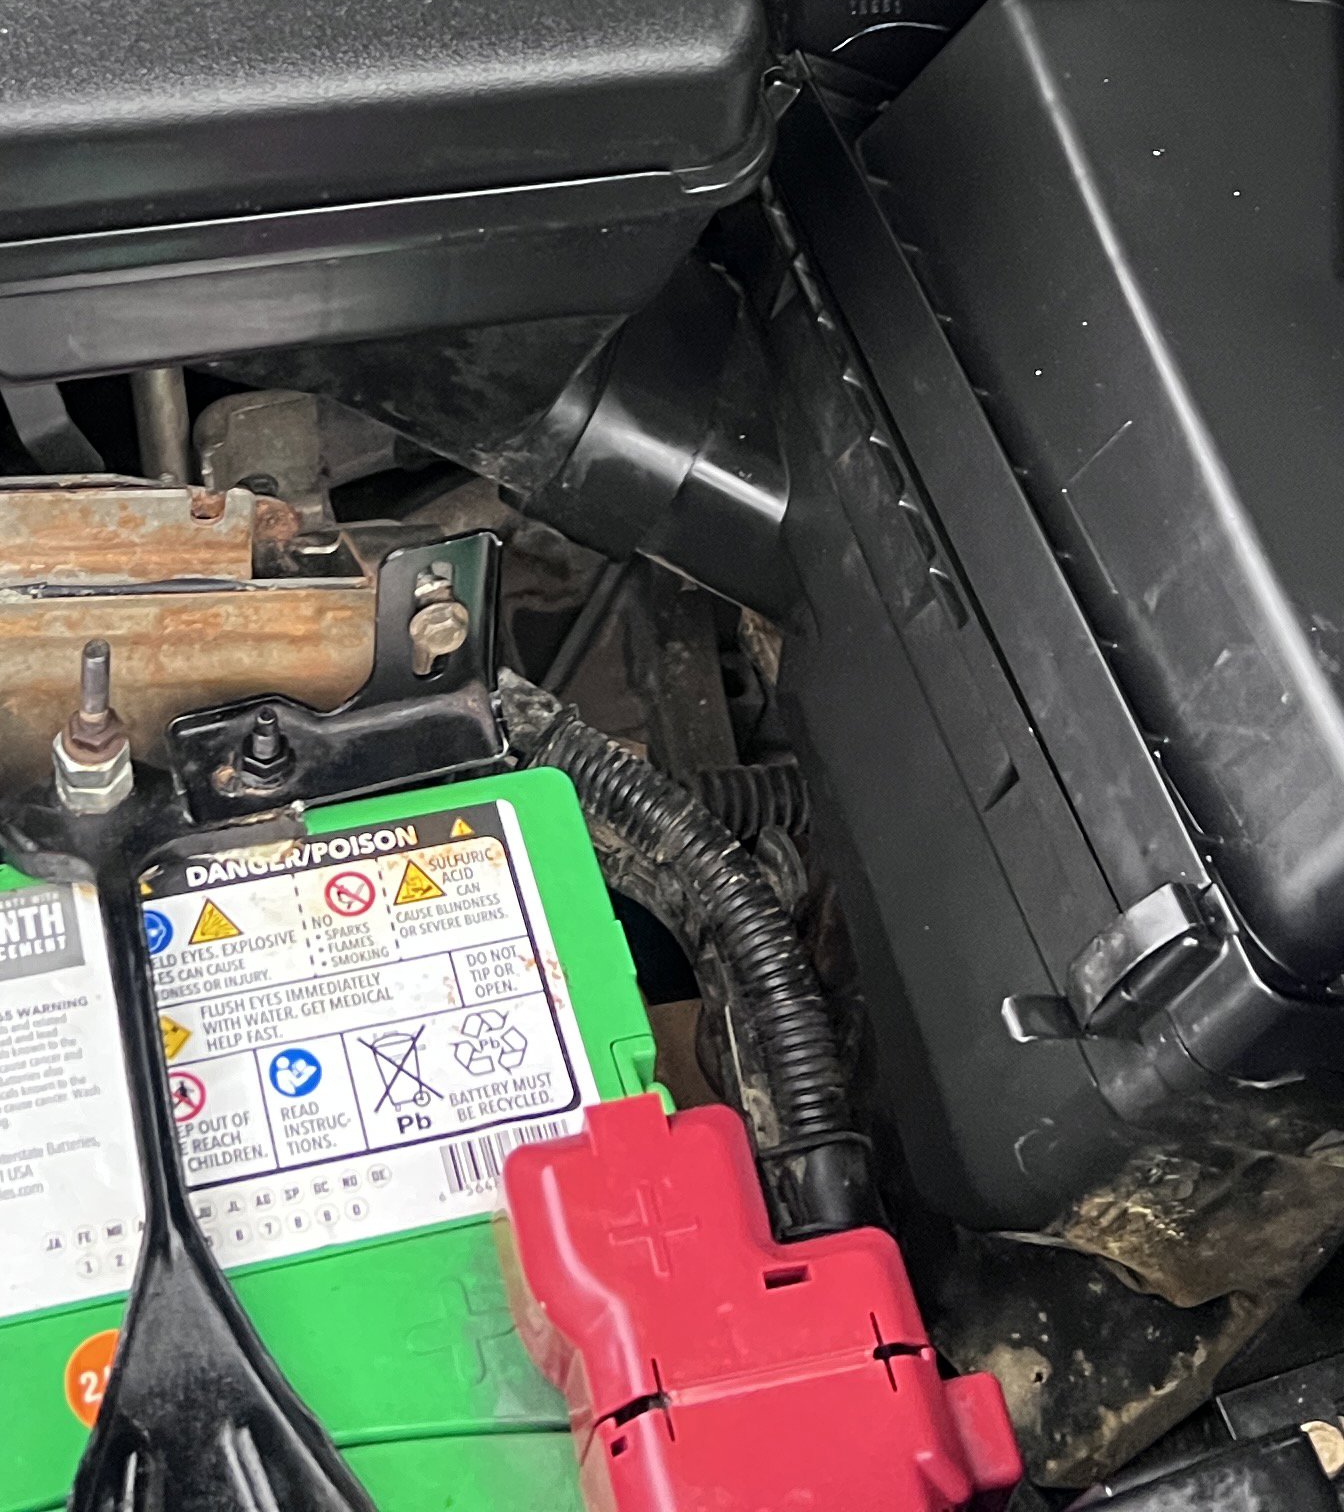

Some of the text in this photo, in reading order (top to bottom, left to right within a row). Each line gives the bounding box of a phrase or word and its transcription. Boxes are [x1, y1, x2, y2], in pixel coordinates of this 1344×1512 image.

[428, 847, 494, 872] SULFURIC
[442, 866, 474, 885] ACID
[456, 882, 481, 896] CAN
[395, 893, 501, 924] CAUSE BLINDNESS
[311, 914, 333, 929] NO
[324, 922, 371, 941] SPARKS
[399, 907, 509, 939] OR SEVERE BURNS.
[181, 945, 219, 965] EYES.
[223, 929, 297, 957] EXPLOSIVE
[328, 935, 375, 954] FLAMES
[466, 945, 519, 967] DO NOT
[330, 947, 390, 968] SMOKING
[177, 966, 204, 982] CAN
[207, 958, 246, 976] CAUSE
[204, 978, 222, 992] OR
[224, 969, 272, 988] INJURY.
[469, 962, 514, 984] TIP OR
[200, 972, 381, 1020] FLUSH EYES IMMEDIATELY
[475, 980, 518, 998] OPEN.
[16, 995, 89, 1020] WARNING
[202, 1013, 243, 1035] WITH
[301, 999, 327, 1017] GET
[330, 988, 394, 1011] MEDICAL
[207, 1024, 283, 1052] HELP FAST.
[479, 1036, 501, 1052] Pb
[449, 1072, 552, 1107] BATTERY MUST
[280, 1101, 320, 1122] READ
[456, 1090, 554, 1123] BE RECYCLED.
[198, 1115, 227, 1135] OUT
[232, 1110, 249, 1128] OF
[284, 1112, 352, 1138] INSTRUC-
[397, 1112, 432, 1134] Pb
[192, 1130, 242, 1154] REACH
[286, 1134, 337, 1156] TIONS.
[188, 1144, 268, 1172] CHILDREN.
[7, 1164, 34, 1181] USA
[80, 1365, 111, 1404] 2
